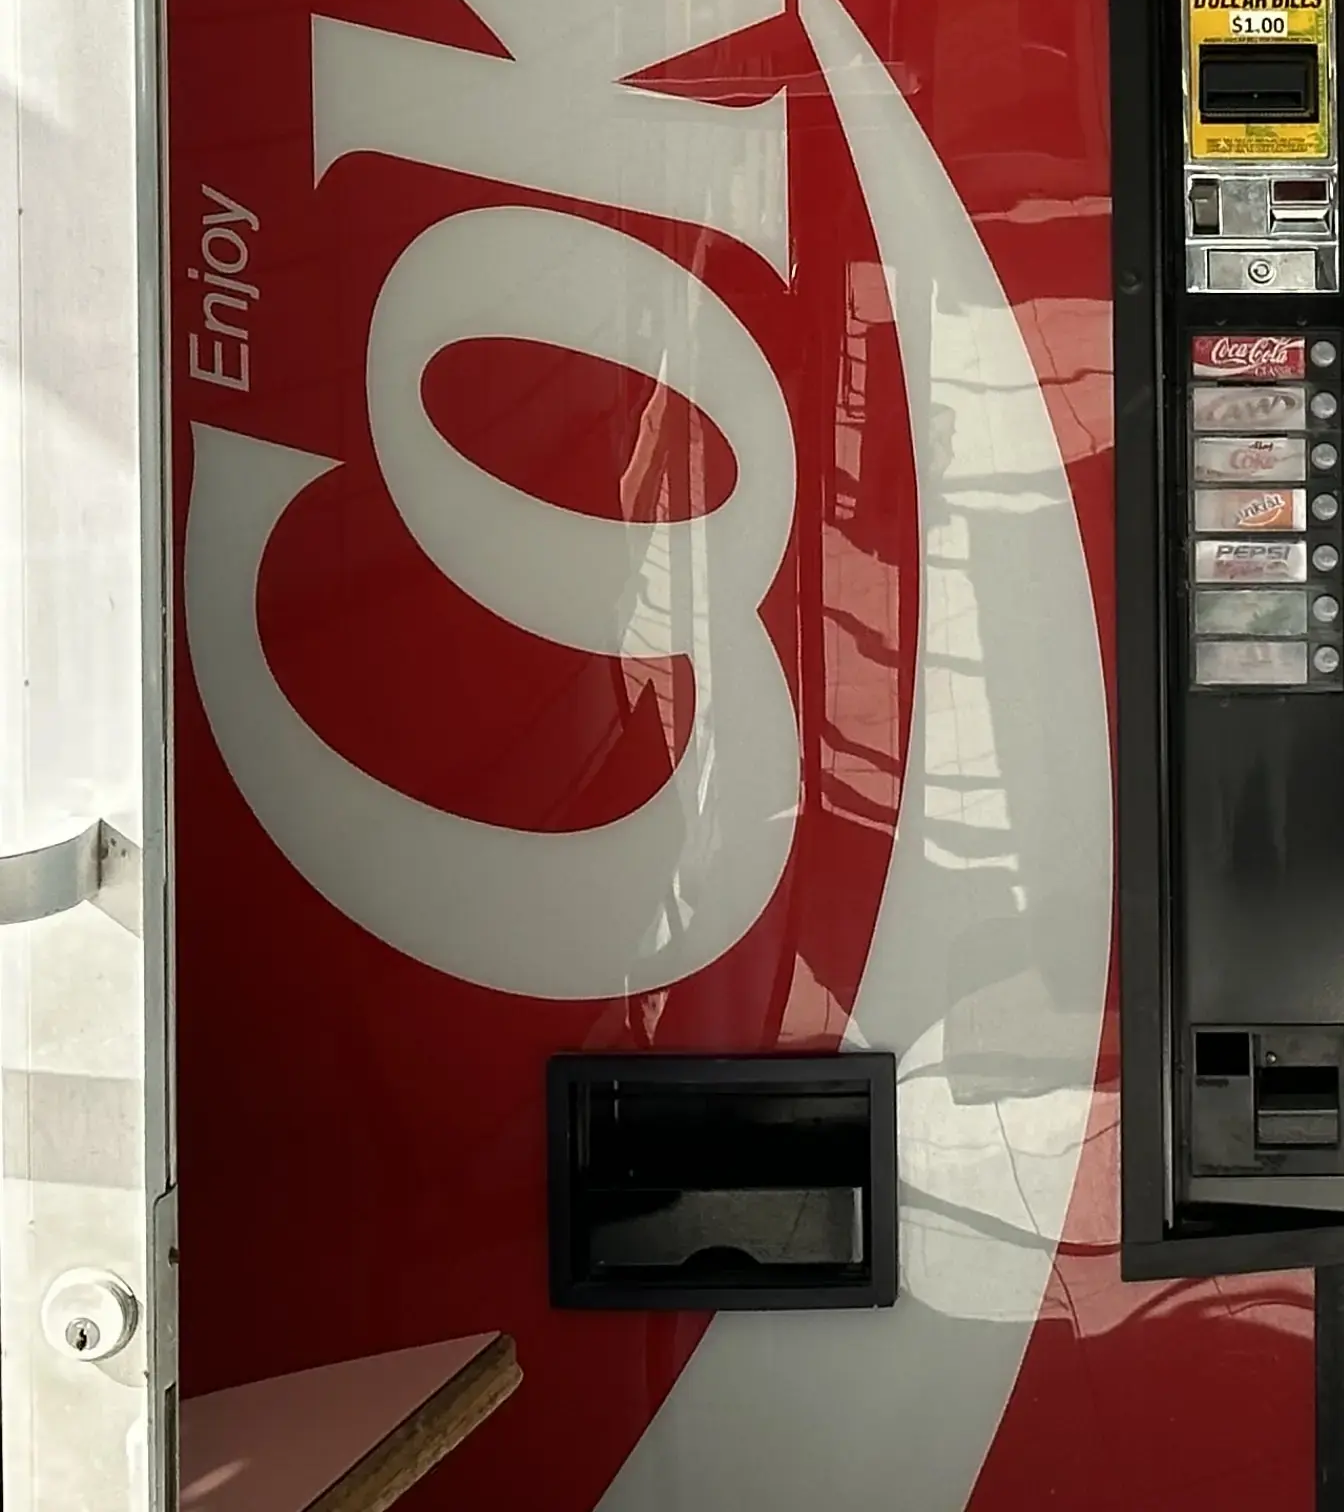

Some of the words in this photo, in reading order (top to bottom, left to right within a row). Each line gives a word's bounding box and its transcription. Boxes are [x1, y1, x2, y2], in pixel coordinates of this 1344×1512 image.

[1231, 15, 1285, 34] $1.00
[187, 183, 260, 393] Enjoy
[1235, 492, 1284, 523] unkist
[1215, 544, 1291, 561] PEPSI
